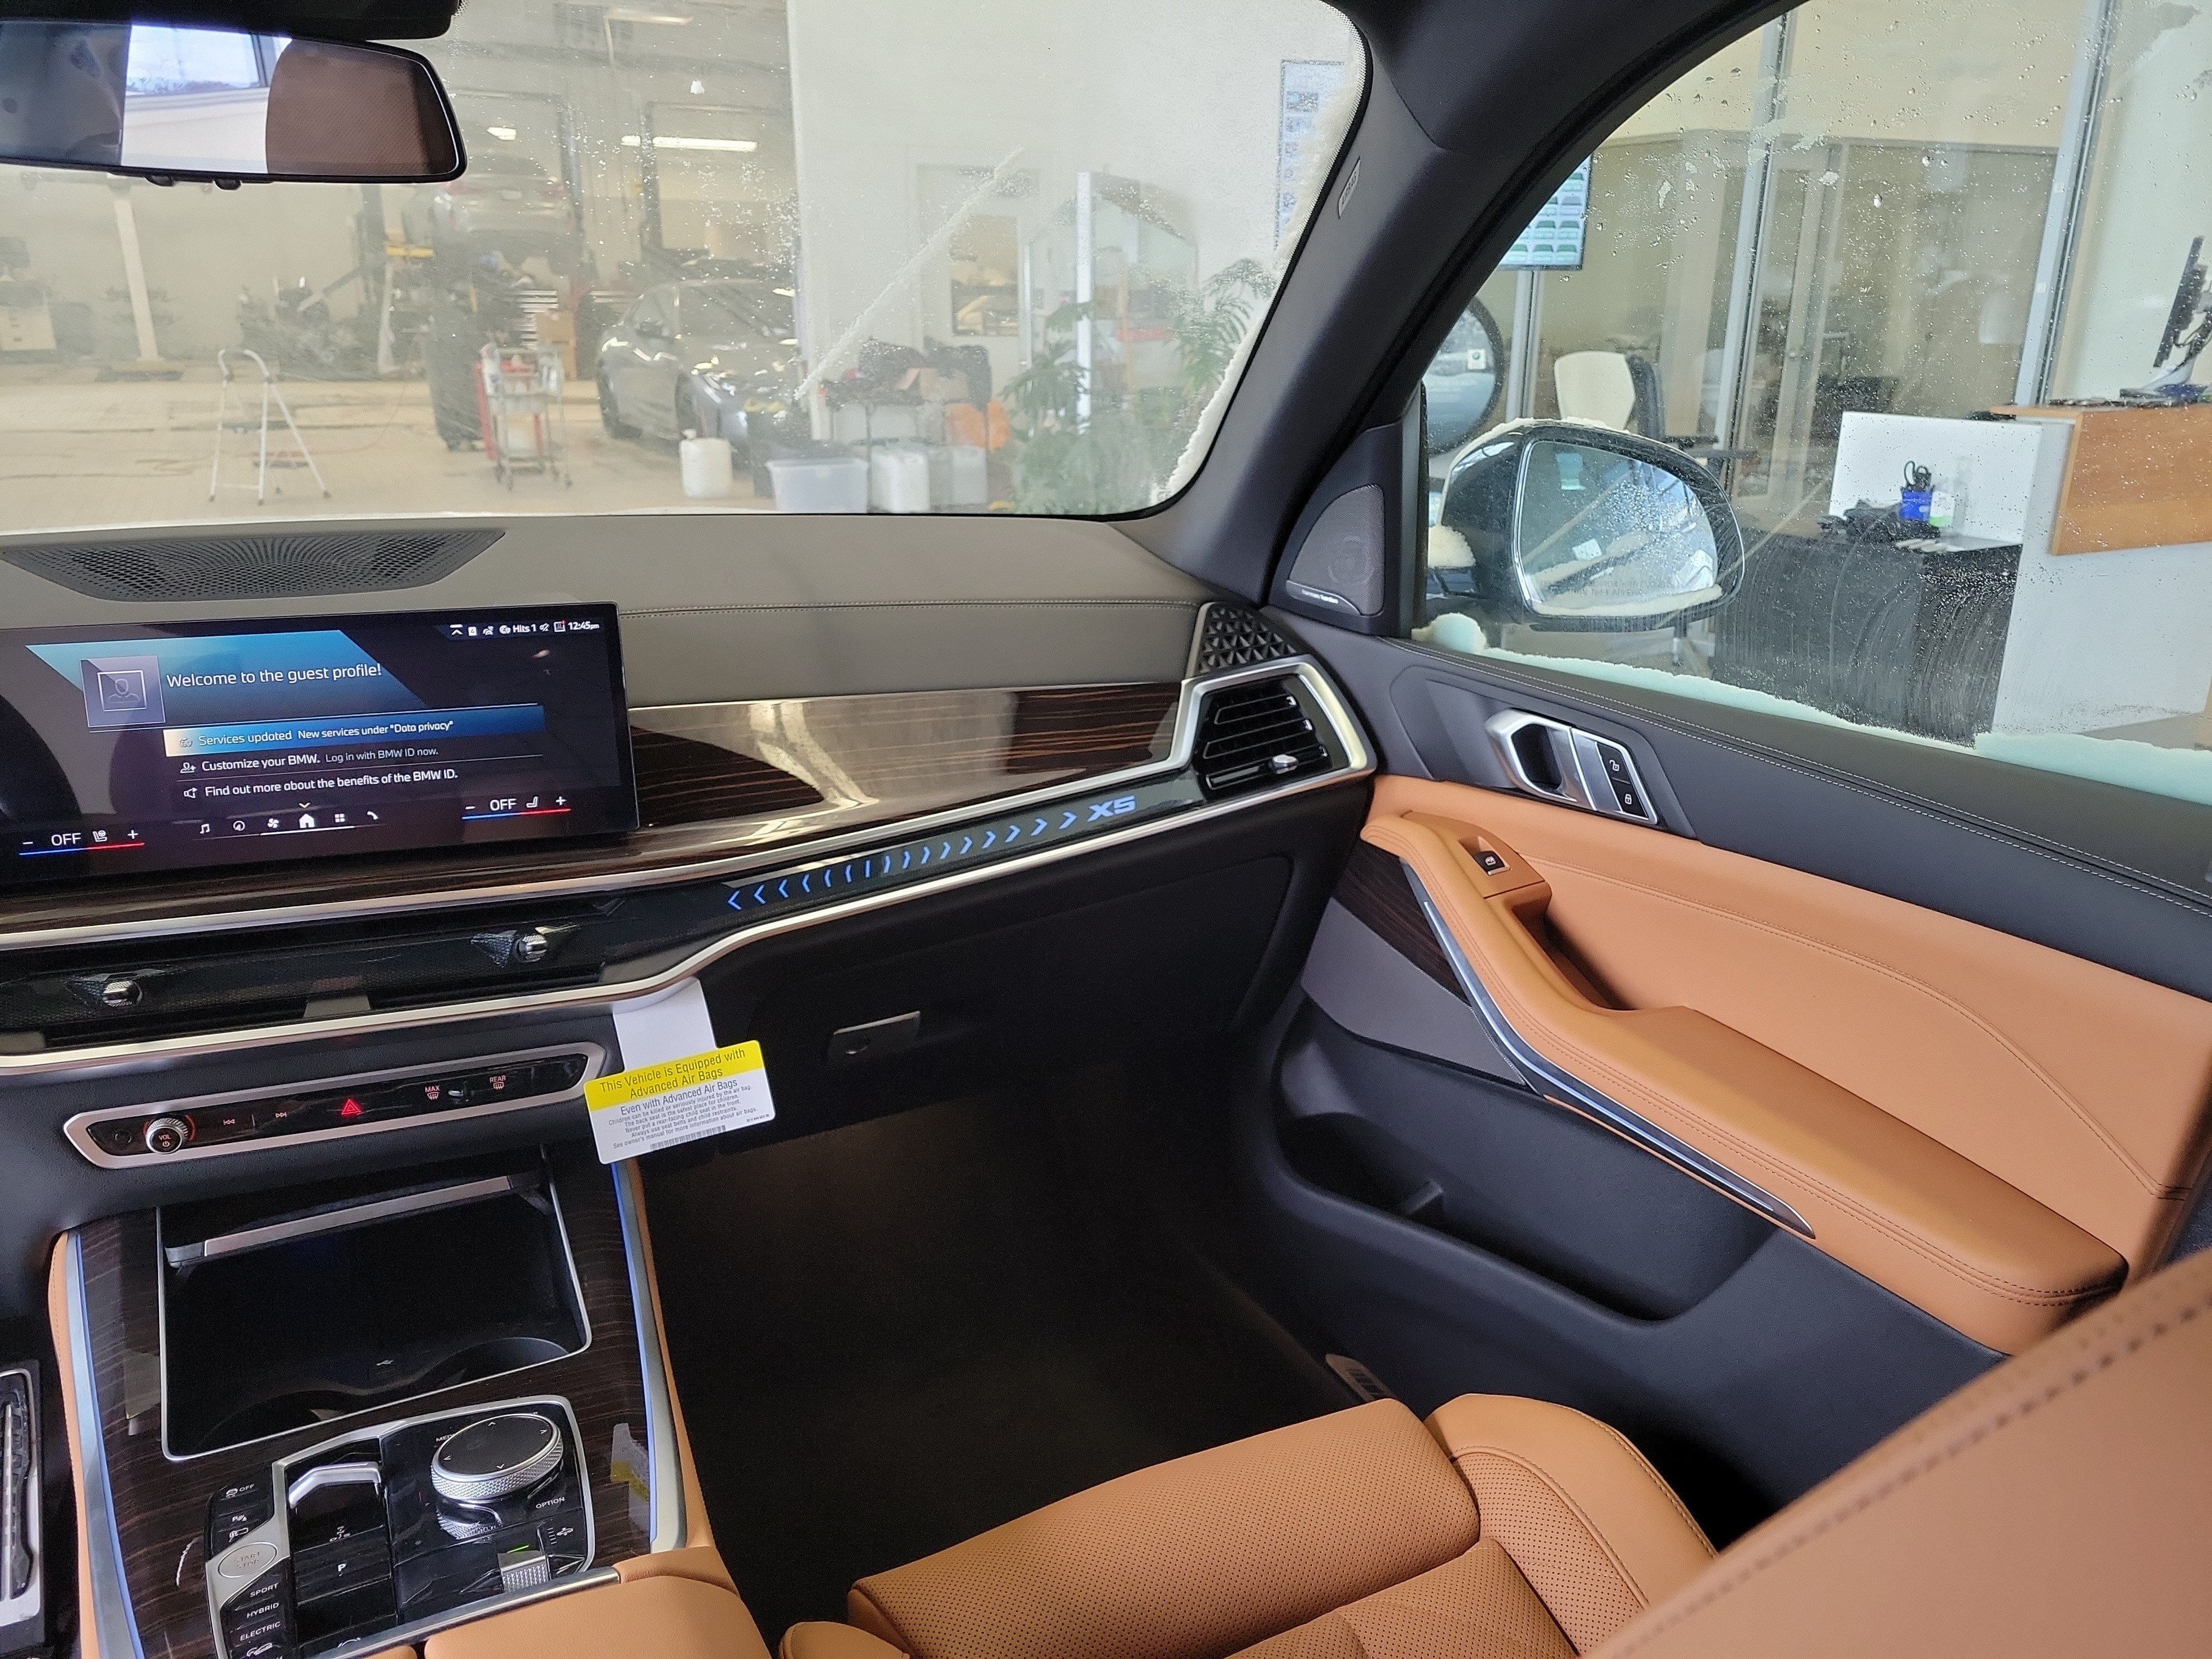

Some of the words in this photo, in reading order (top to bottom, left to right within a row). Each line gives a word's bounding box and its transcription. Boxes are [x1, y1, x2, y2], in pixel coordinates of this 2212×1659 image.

[512, 625, 531, 633] Hits
[531, 624, 537, 632] 1
[568, 621, 600, 630] 12:45pm
[166, 673, 236, 687] Welcome
[240, 673, 256, 683] to
[259, 669, 284, 682] the
[287, 667, 329, 684] guest
[332, 663, 381, 681] profile!
[199, 734, 245, 746] Services
[247, 730, 292, 743] updated
[298, 730, 319, 739] New
[321, 727, 360, 738] services
[362, 725, 388, 735] under
[390, 724, 416, 733] "Data
[418, 720, 453, 732] privacy"
[202, 758, 260, 771] Customize
[261, 758, 286, 769] your
[288, 754, 320, 765] BMW.
[325, 754, 343, 763] Log
[346, 752, 354, 760] in
[356, 751, 376, 760] with
[377, 749, 402, 759] BMW
[405, 748, 414, 757] ID
[417, 747, 439, 756] now.
[205, 786, 230, 796] Find
[232, 785, 251, 795] out
[253, 783, 281, 793] more
[284, 780, 315, 791] about
[317, 778, 336, 788] the
[337, 775, 379, 787] benefits
[381, 773, 393, 783] of
[393, 772, 411, 782] the
[413, 770, 441, 781] BMW
[444, 769, 459, 779] ID.
[490, 798, 517, 811] OFF
[1087, 795, 1136, 822] X5
[51, 833, 81, 846] OFF
[600, 1080, 622, 1092] This
[624, 1070, 661, 1086] Vehicle
[664, 1067, 673, 1077] is
[676, 1054, 721, 1074] Equipped
[724, 1048, 746, 1062] with
[490, 1075, 506, 1084] REAR
[630, 1077, 678, 1099] Advanced
[682, 1074, 695, 1086] Air
[698, 1068, 723, 1081] Bags
[425, 1085, 440, 1093] MAX
[620, 1104, 641, 1115] Even
[642, 1098, 660, 1109] with
[663, 1087, 702, 1105] Advanced
[704, 1084, 715, 1094] Air
[717, 1079, 737, 1091] Bags
[717, 1094, 740, 1103] children.
[608, 1116, 630, 1126] Children
[673, 1099, 696, 1109] seriously
[697, 1093, 715, 1103] injured
[657, 1114, 684, 1125] rear-facing
[624, 1136, 645, 1146] owner's
[646, 1130, 664, 1139] manual
[690, 1117, 719, 1128] information
[631, 1129, 650, 1138] Always
[239, 1483, 255, 1492] OFF
[535, 1497, 565, 1509] OPTION
[234, 1551, 260, 1563] START
[236, 1559, 259, 1569] STOP
[337, 1564, 346, 1572] P
[250, 1582, 279, 1598] SPORT
[247, 1602, 280, 1618] HYBRID
[240, 1621, 281, 1641] ELECTRIC
